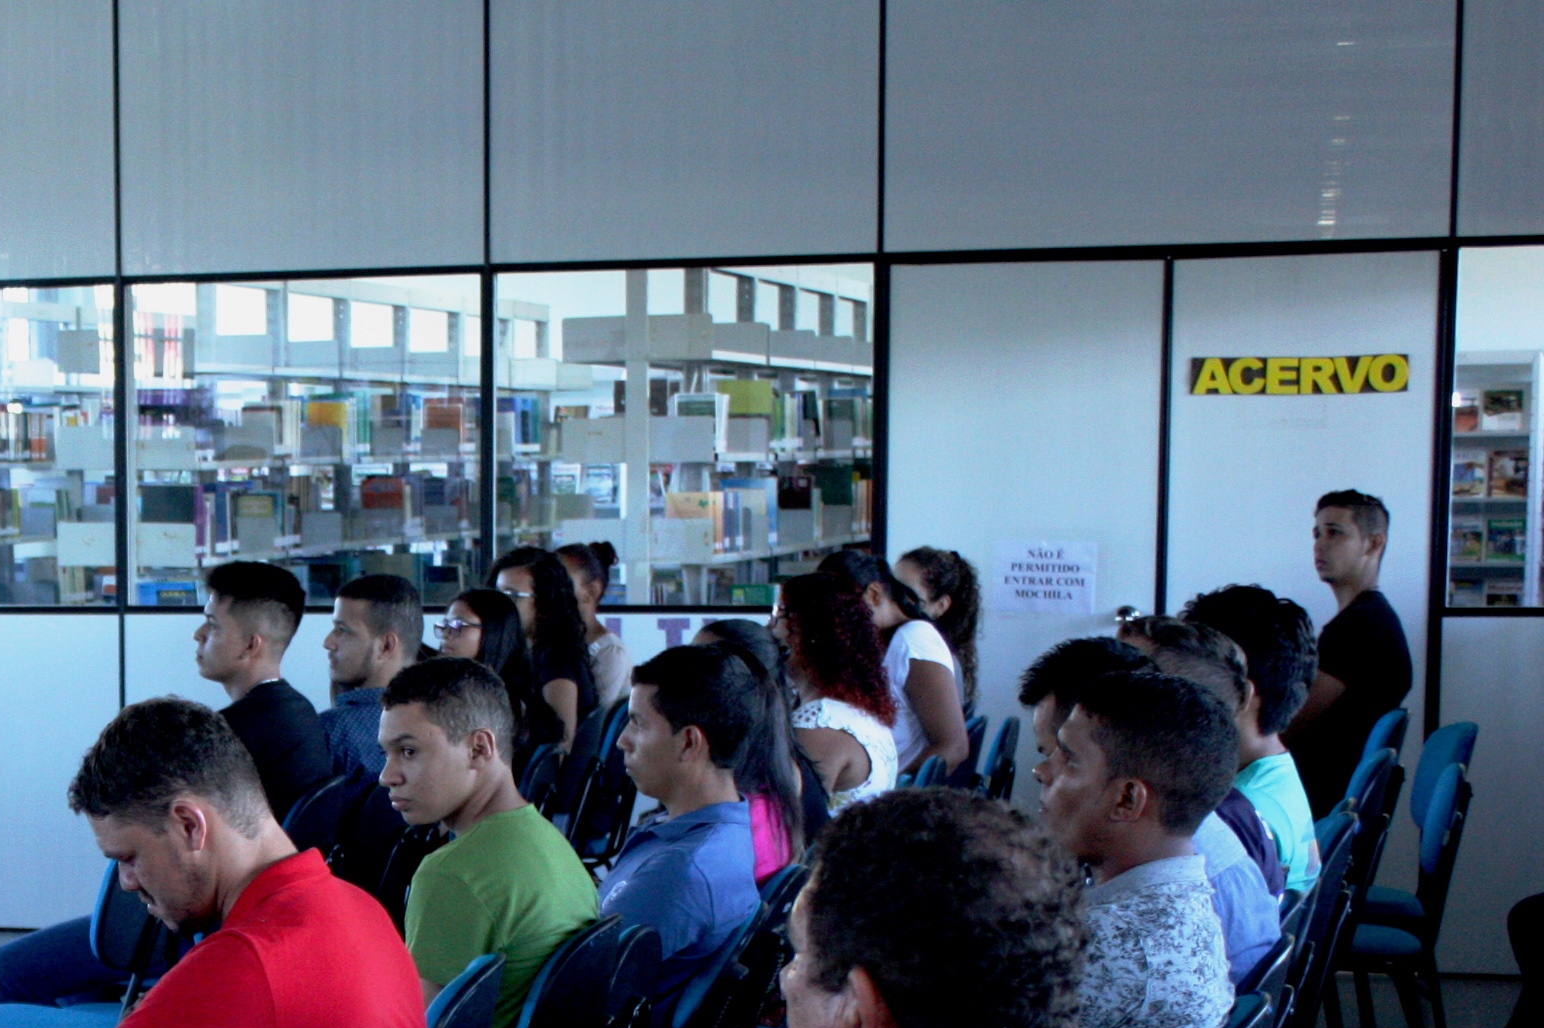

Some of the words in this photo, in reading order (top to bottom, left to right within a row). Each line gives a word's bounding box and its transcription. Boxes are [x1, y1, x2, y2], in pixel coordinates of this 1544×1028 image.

[1192, 354, 1409, 395] ACERVO
[1028, 547, 1054, 560] NÃO
[1056, 547, 1065, 560] É
[1010, 562, 1081, 574] PERMITIDO
[1003, 575, 1054, 587] ENTRAR
[1056, 576, 1086, 588] COM
[1015, 588, 1074, 600] MOCHILA
